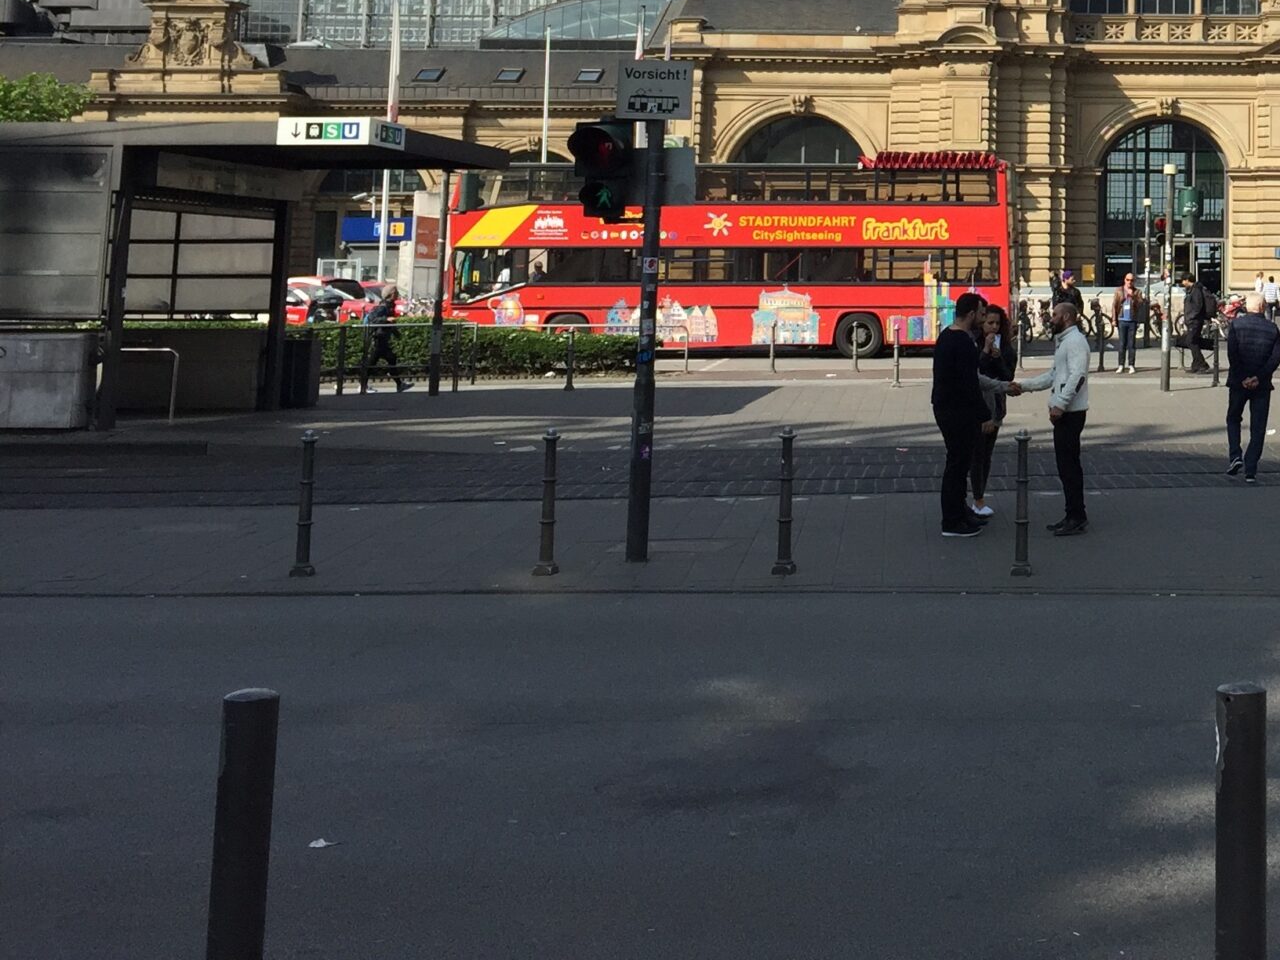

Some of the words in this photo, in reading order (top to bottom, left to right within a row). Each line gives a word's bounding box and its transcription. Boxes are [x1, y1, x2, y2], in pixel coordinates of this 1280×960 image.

[327, 124, 338, 138] S
[344, 124, 357, 138] U
[738, 215, 857, 227] STADTRUNDFAHRT
[752, 229, 843, 242] CitySightseeing
[862, 217, 950, 241] Frankfurt
